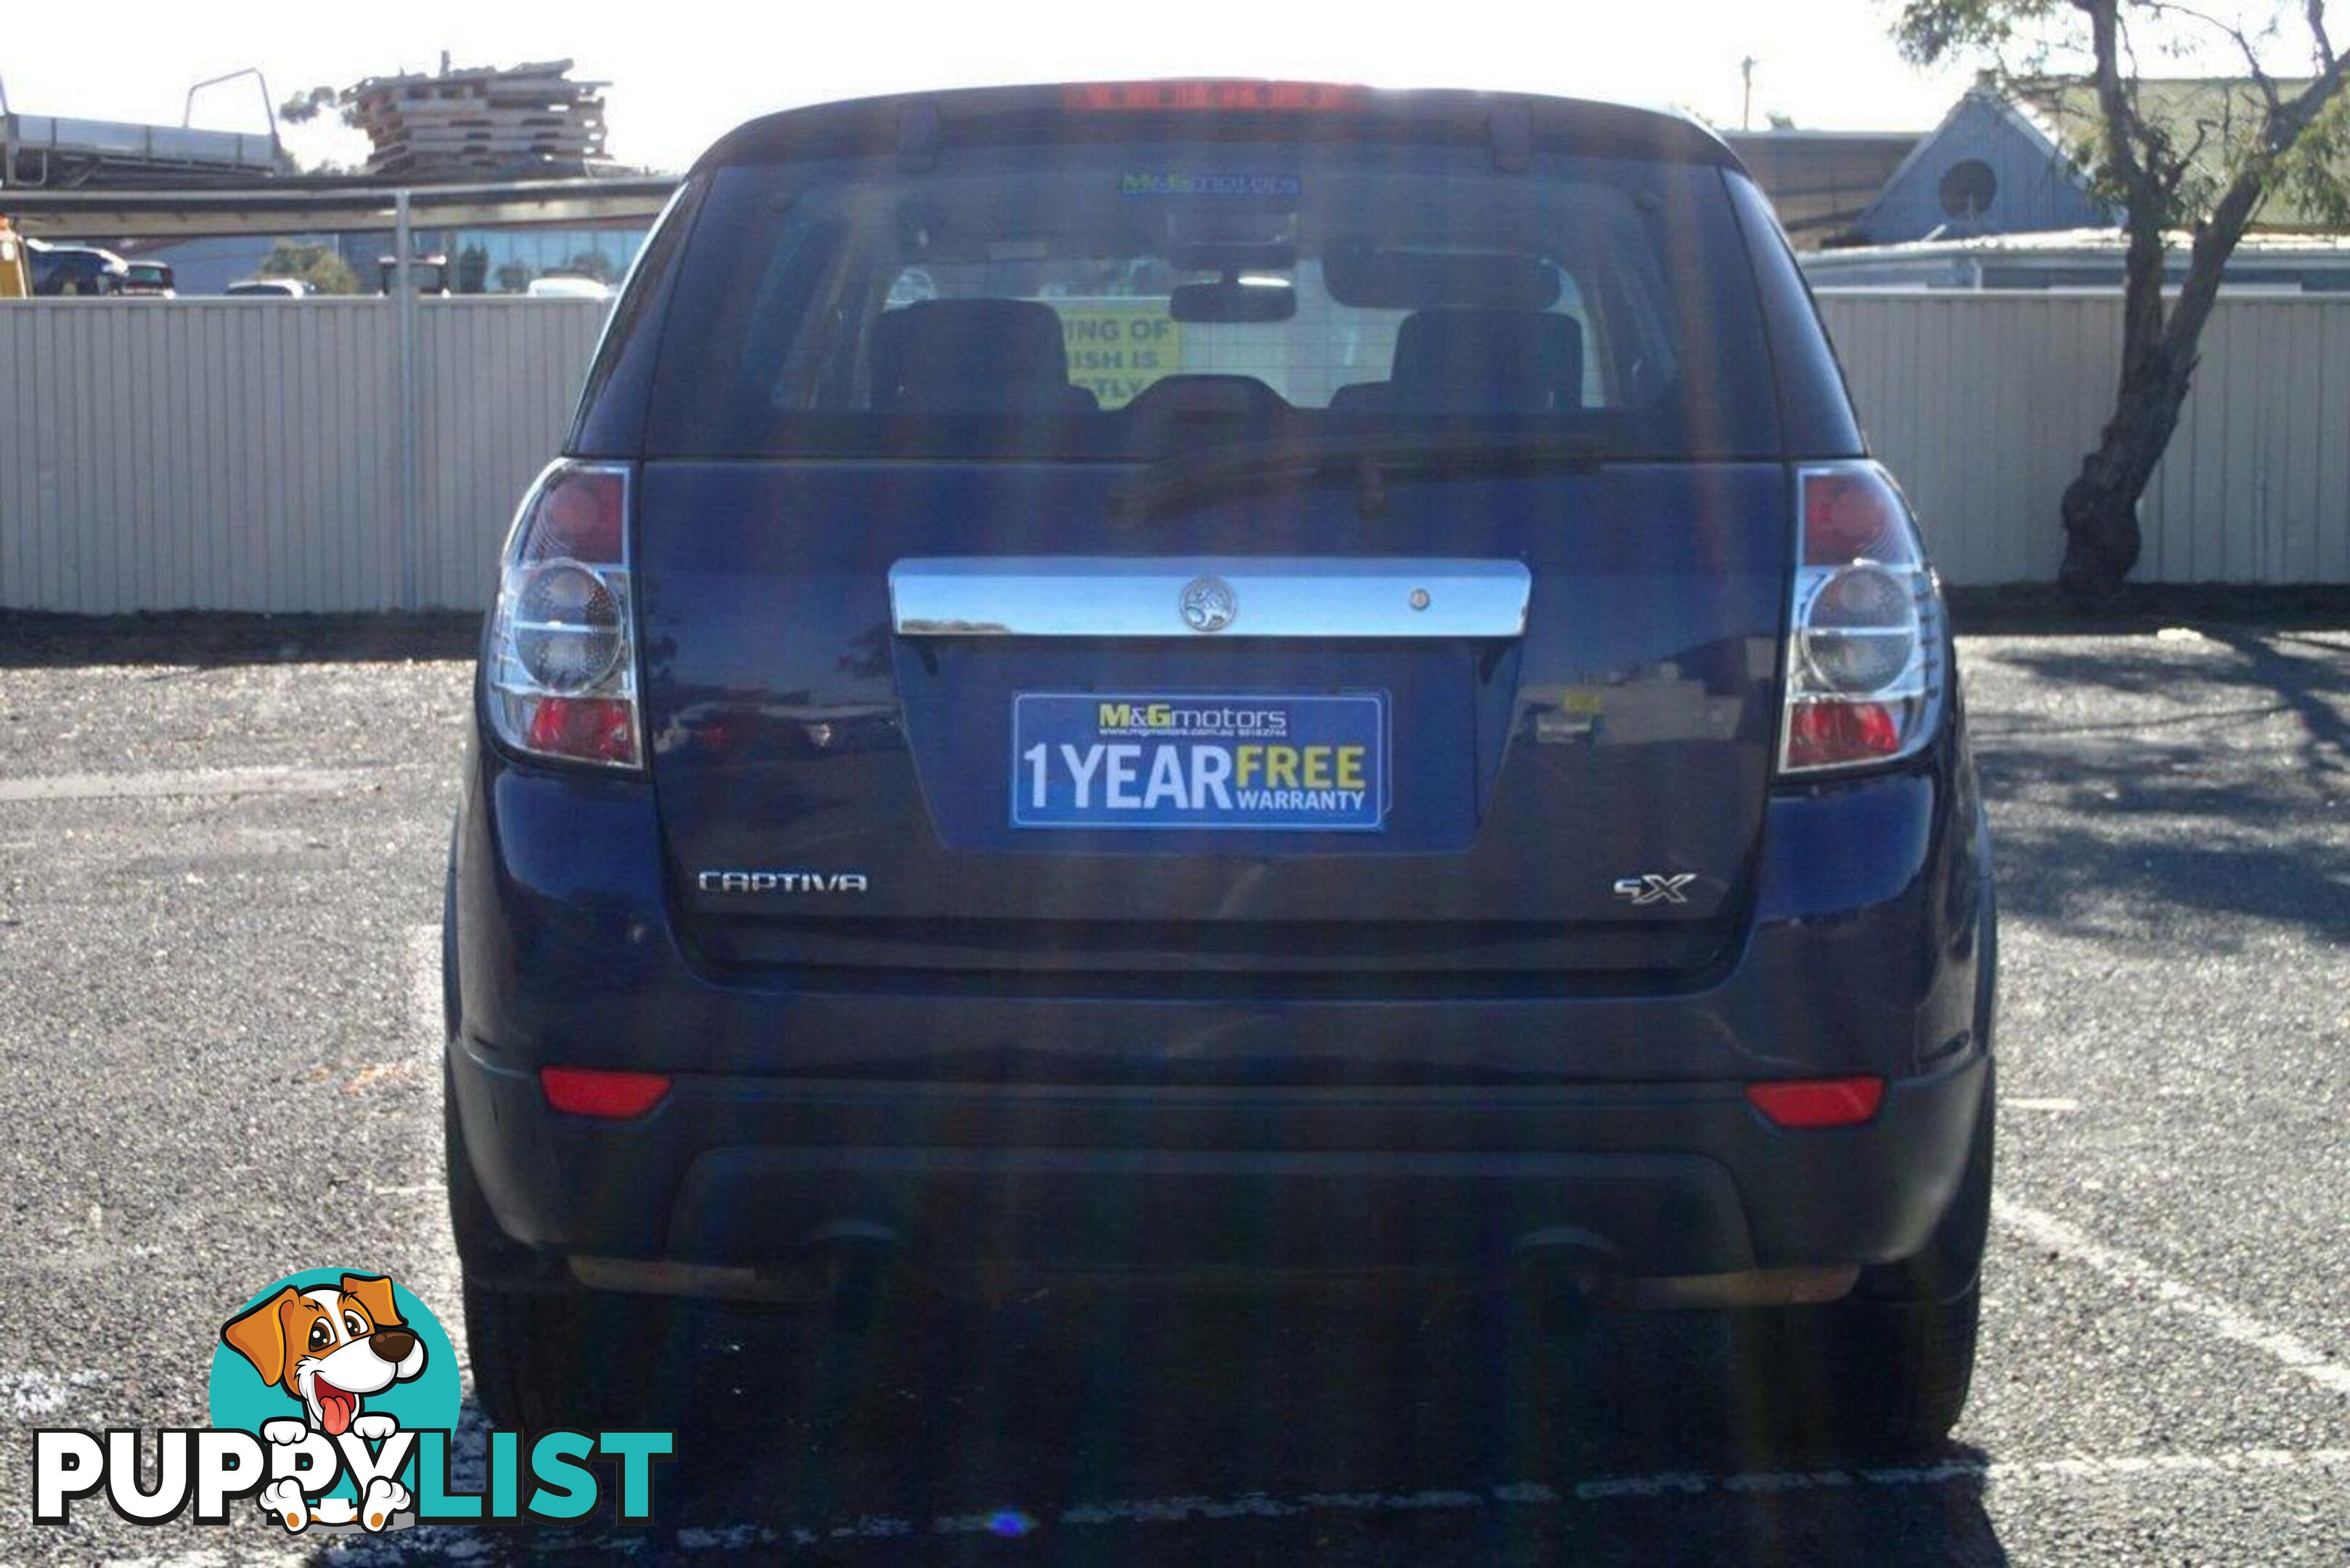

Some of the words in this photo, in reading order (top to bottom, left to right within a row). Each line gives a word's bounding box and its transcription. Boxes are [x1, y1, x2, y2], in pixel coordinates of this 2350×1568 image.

[1131, 318, 1170, 340] OF
[1133, 351, 1159, 369] IS
[1098, 703, 1286, 727] M&Gmotors
[1024, 743, 1046, 808] 1
[1061, 745, 1233, 809] YEAR
[1237, 746, 1366, 789] FREE
[1237, 791, 1366, 811] WARRANTY
[698, 872, 868, 892] CAPTIVA
